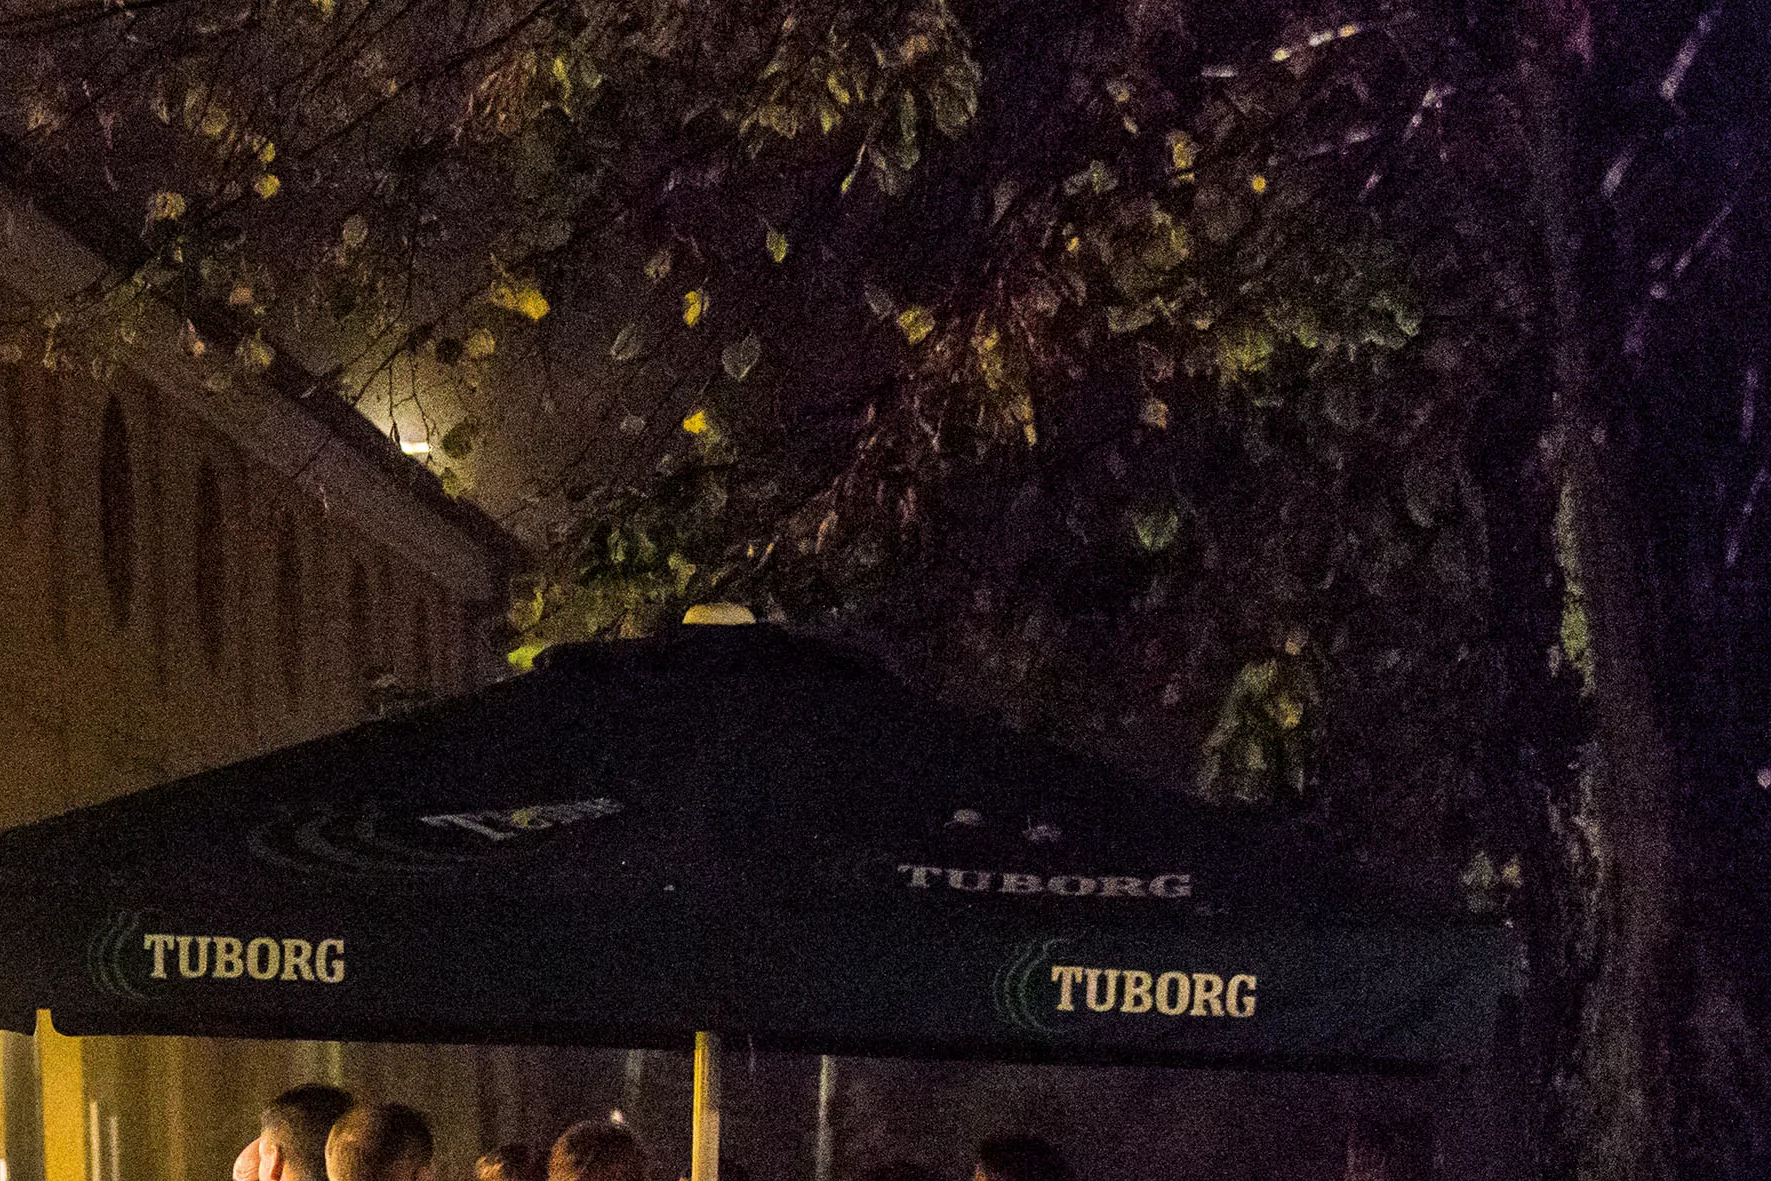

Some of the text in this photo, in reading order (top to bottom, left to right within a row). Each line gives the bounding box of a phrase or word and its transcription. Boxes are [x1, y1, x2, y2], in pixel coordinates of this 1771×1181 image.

[897, 864, 1192, 898] TUBORG
[143, 933, 346, 983] TUBORG
[1050, 965, 1257, 1018] TUBORG
